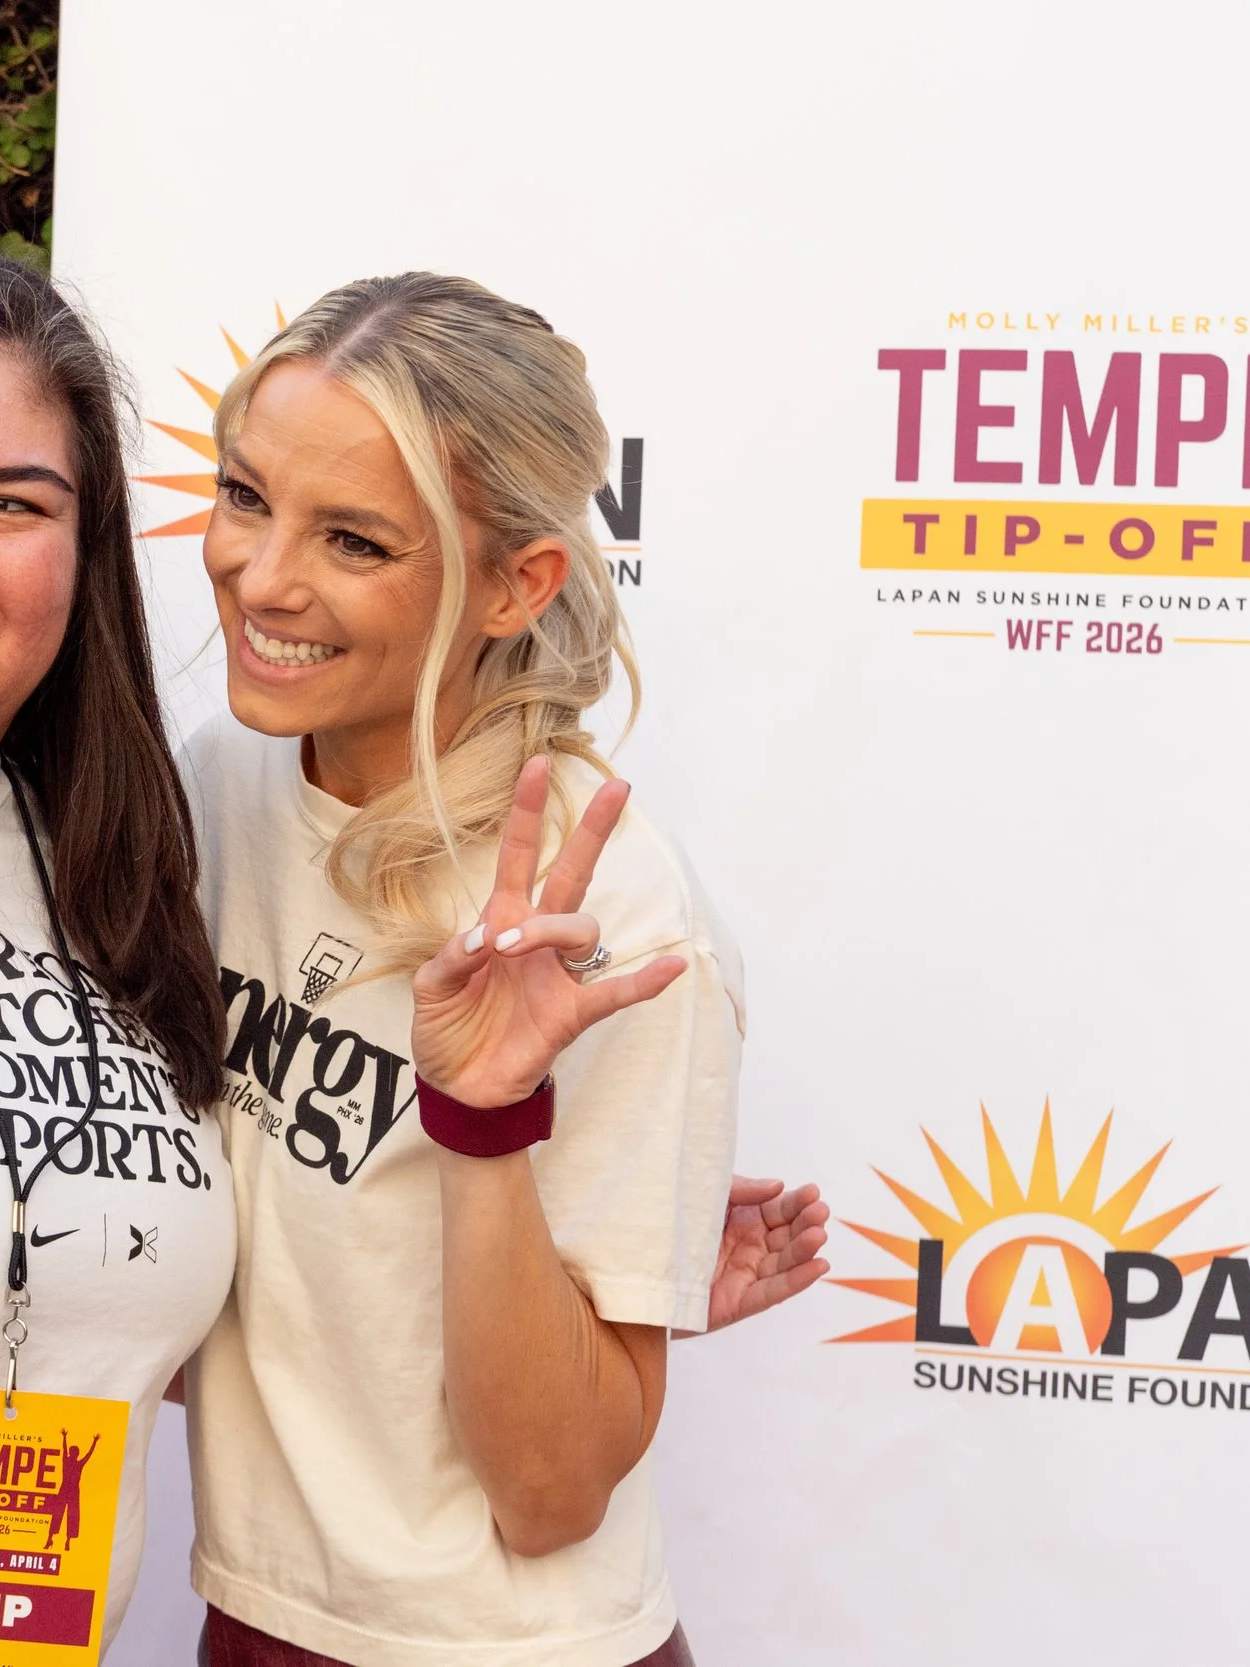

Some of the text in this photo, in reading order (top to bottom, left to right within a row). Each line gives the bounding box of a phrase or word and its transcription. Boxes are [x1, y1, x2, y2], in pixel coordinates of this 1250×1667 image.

[948, 311, 1250, 335] MOLLY MILLER'S
[877, 348, 1250, 490] TEMP
[877, 588, 962, 604] LAPAN
[976, 590, 1106, 608] SUNSHINE
[1006, 618, 1164, 655] WFF 2026
[230, 1080, 263, 1116] the
[337, 1105, 352, 1120] PHX
[912, 1360, 1114, 1402] SUNSHINE
[9, 1554, 44, 1570] APRIL
[49, 1557, 57, 1571] 4
